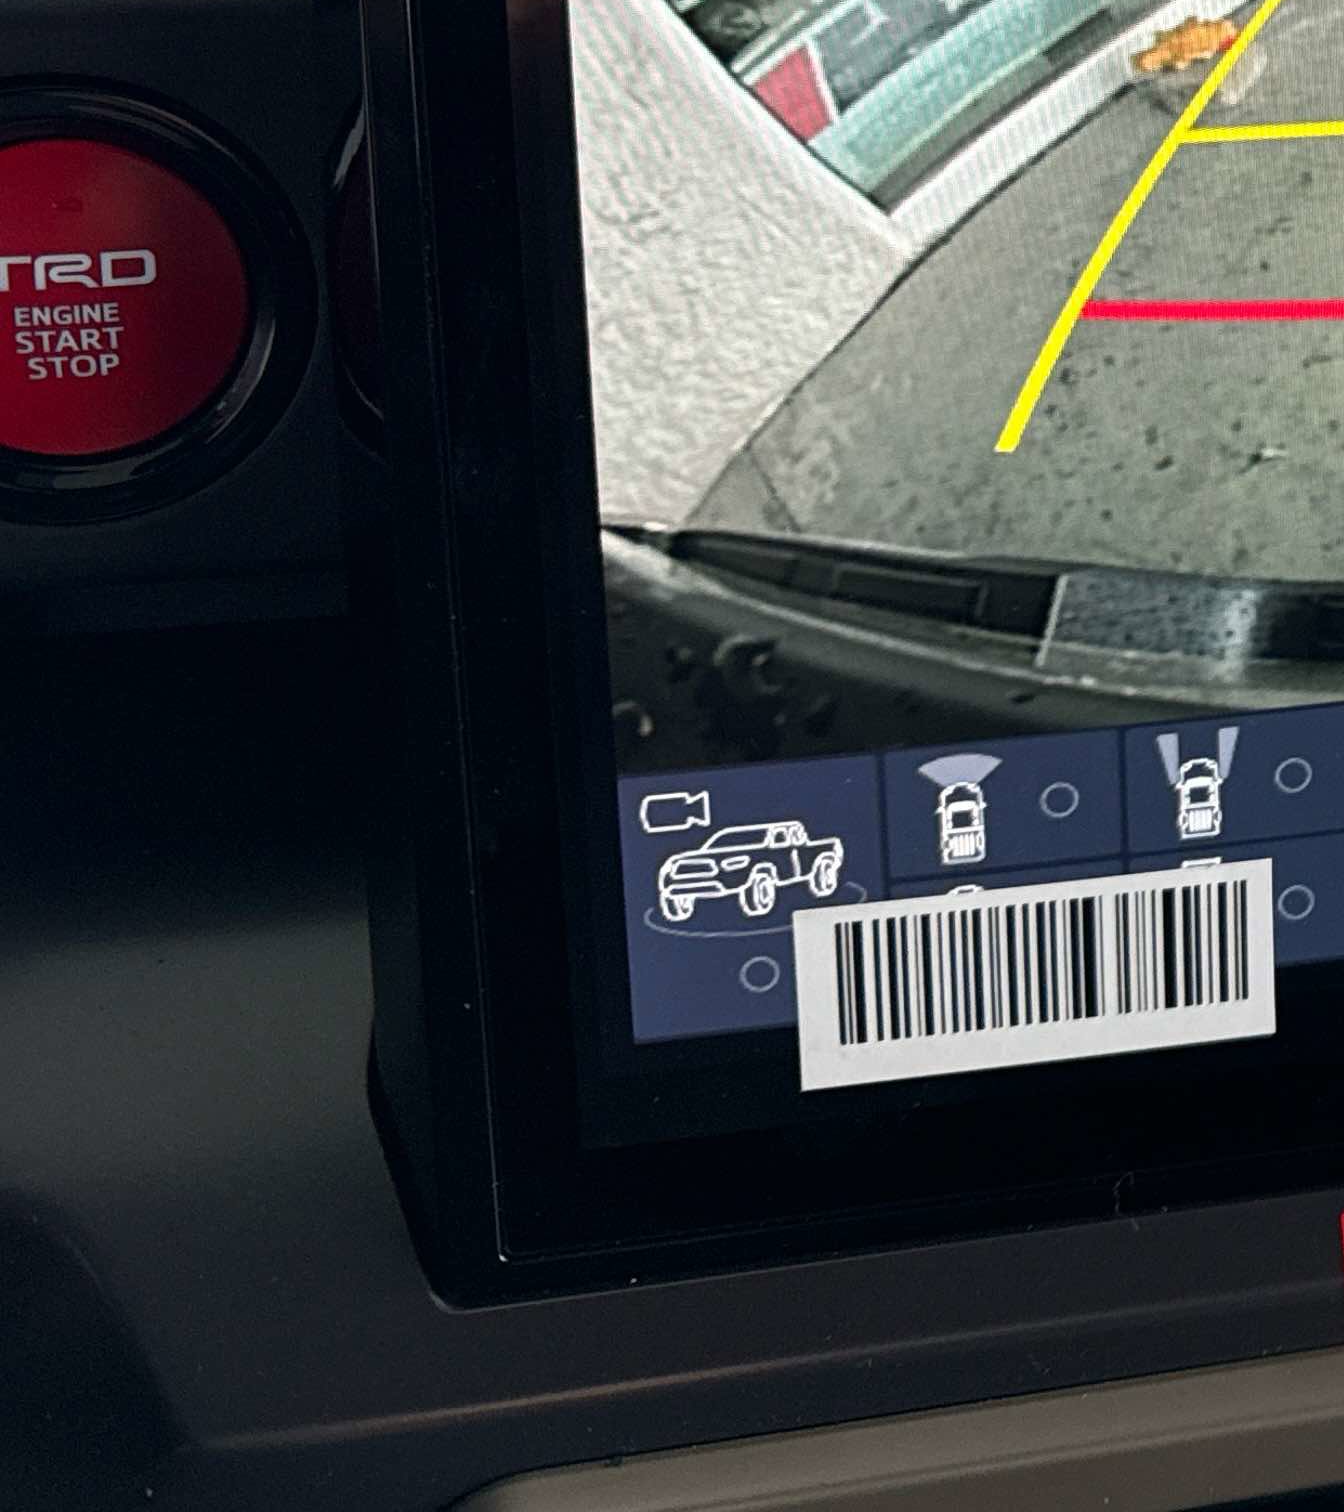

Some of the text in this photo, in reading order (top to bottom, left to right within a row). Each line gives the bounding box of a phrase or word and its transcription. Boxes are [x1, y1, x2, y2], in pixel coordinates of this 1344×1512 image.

[0, 248, 157, 291] TRD
[14, 302, 120, 327] ENGINE
[15, 326, 124, 355] START
[28, 354, 120, 380] STOP
